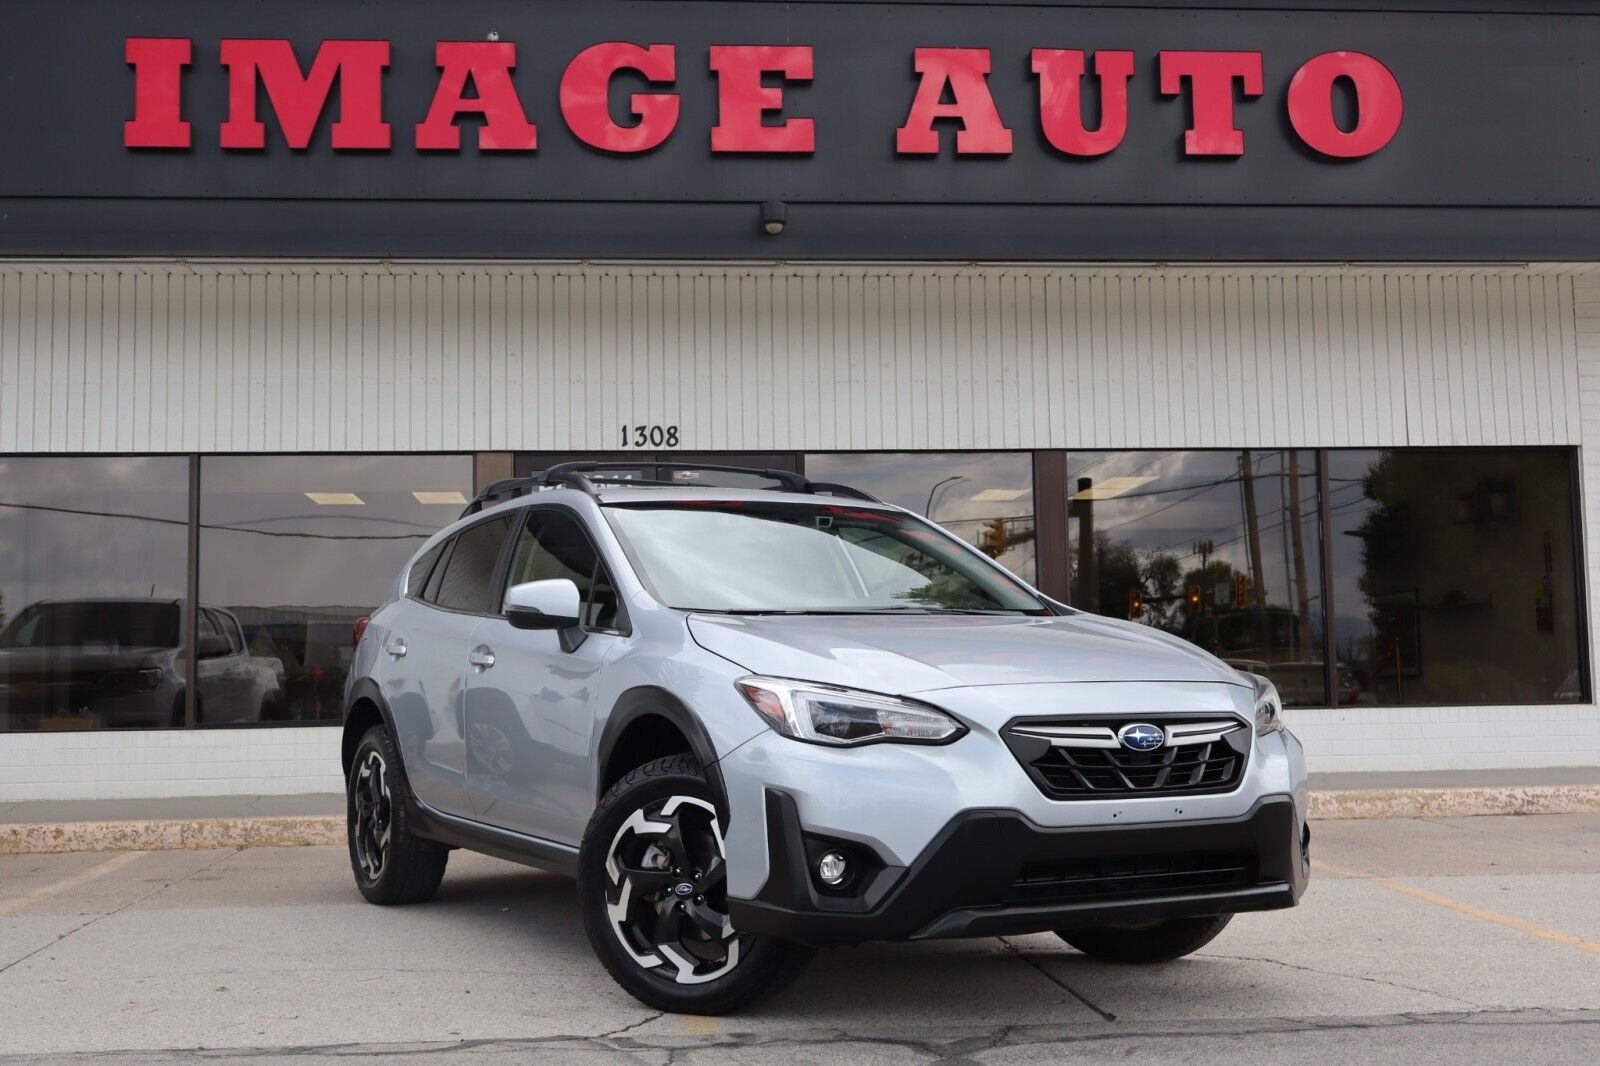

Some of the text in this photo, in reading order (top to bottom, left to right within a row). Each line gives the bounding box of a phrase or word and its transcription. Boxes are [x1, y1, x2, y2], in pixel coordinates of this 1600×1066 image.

[124, 38, 1404, 158] IMAGE AUTO
[621, 425, 679, 447] 1308
